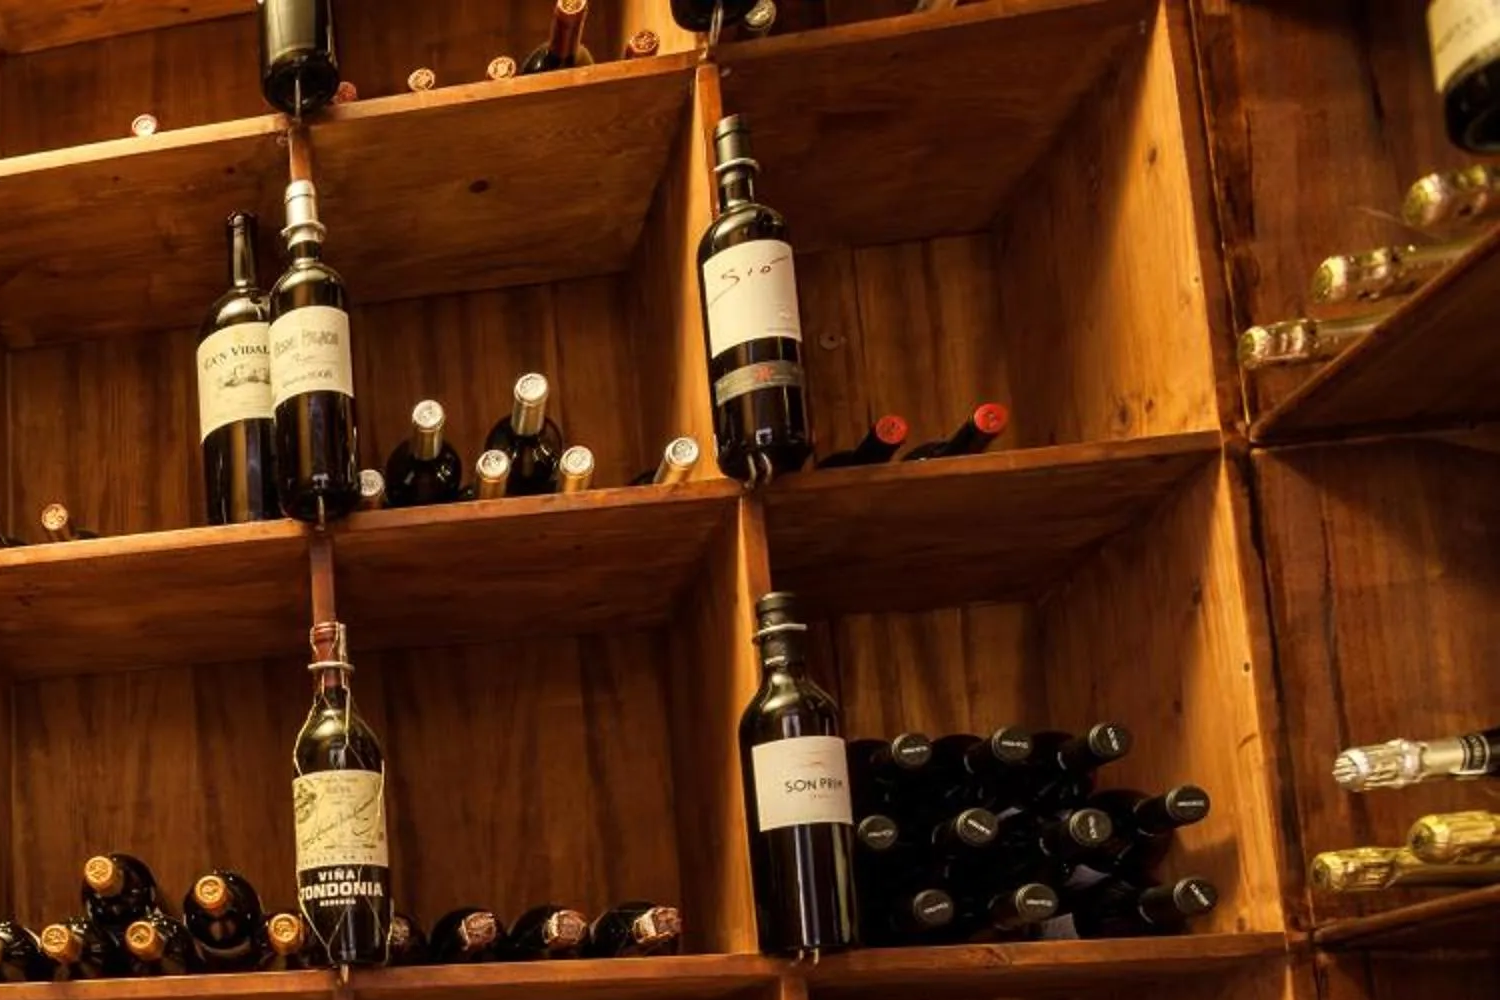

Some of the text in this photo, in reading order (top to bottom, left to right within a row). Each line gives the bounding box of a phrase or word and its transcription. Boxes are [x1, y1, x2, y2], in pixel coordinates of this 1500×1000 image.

[231, 344, 269, 356] VIDAL
[785, 779, 817, 793] SON
[318, 868, 356, 882] VIÑA
